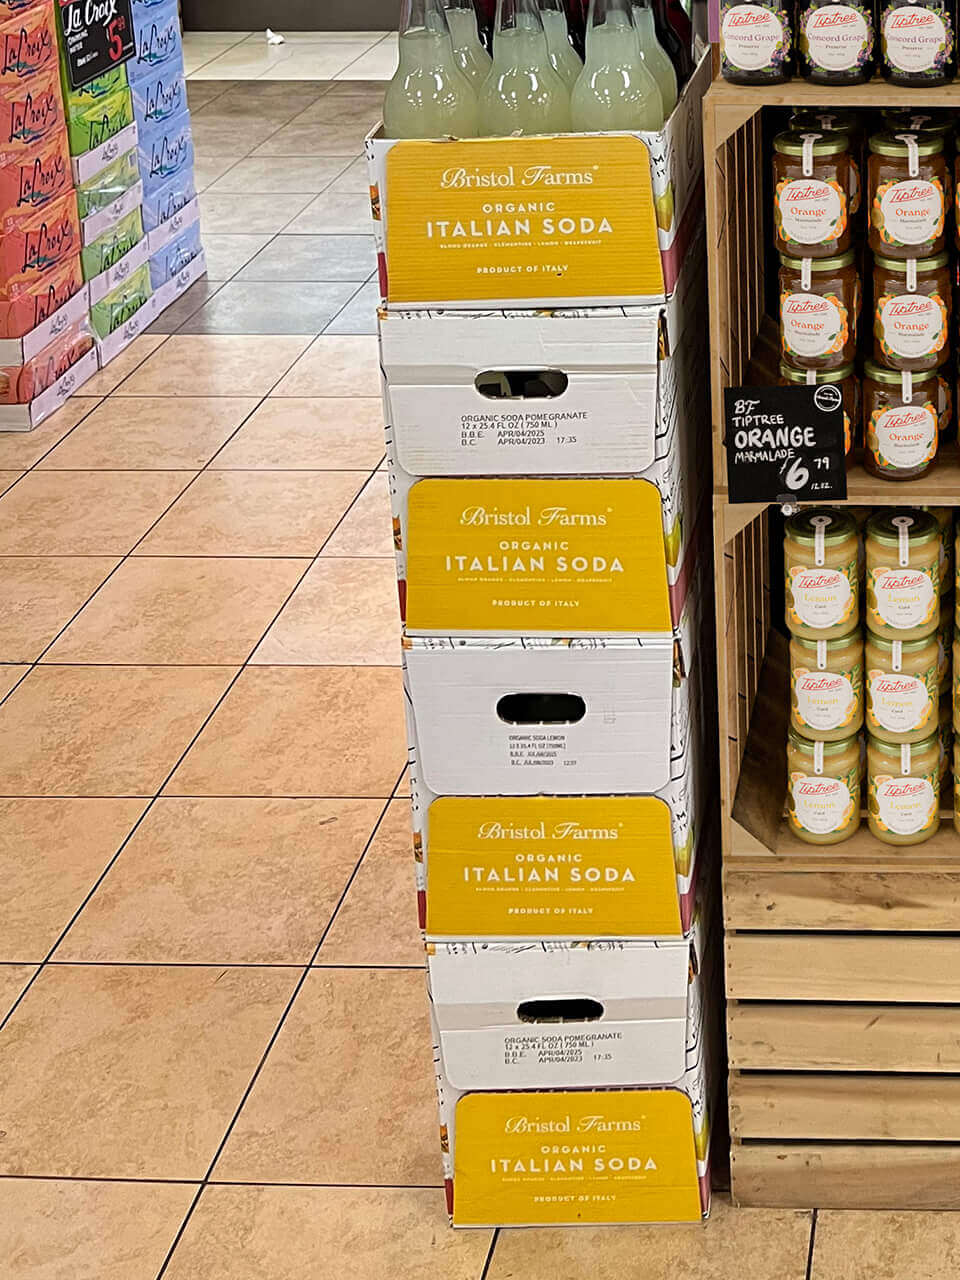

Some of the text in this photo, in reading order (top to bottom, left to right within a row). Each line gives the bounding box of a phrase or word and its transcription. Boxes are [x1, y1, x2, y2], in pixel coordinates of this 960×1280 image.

[813, 12, 858, 29] Tiptree
[841, 33, 865, 44] Grape
[440, 165, 593, 189] Bristol Farms
[784, 185, 831, 202] Tiptree
[482, 202, 556, 214] ORGANIC
[790, 207, 827, 217] Orange
[427, 217, 614, 238] ITALIAN SODA
[476, 266, 522, 274] PRODUCT
[542, 264, 569, 272] ITALY
[461, 411, 588, 422] ORGANIC SODA POMEGRANATE
[732, 414, 784, 427] TIPTREE
[734, 426, 817, 449] ORANGE
[734, 448, 796, 464] MARMALADE
[460, 506, 608, 527] Bristol Farms
[499, 540, 570, 551] ORGANIC
[446, 556, 625, 572] ITALIAN SODA
[477, 821, 619, 840] Bristol Farms
[515, 853, 583, 863] ORGANIC
[464, 867, 636, 882] ITALIAN SODA
[505, 1115, 641, 1134] Bristol Farms
[541, 1144, 607, 1154] ORGANIC
[491, 1156, 657, 1173] ITALIAN SODA
